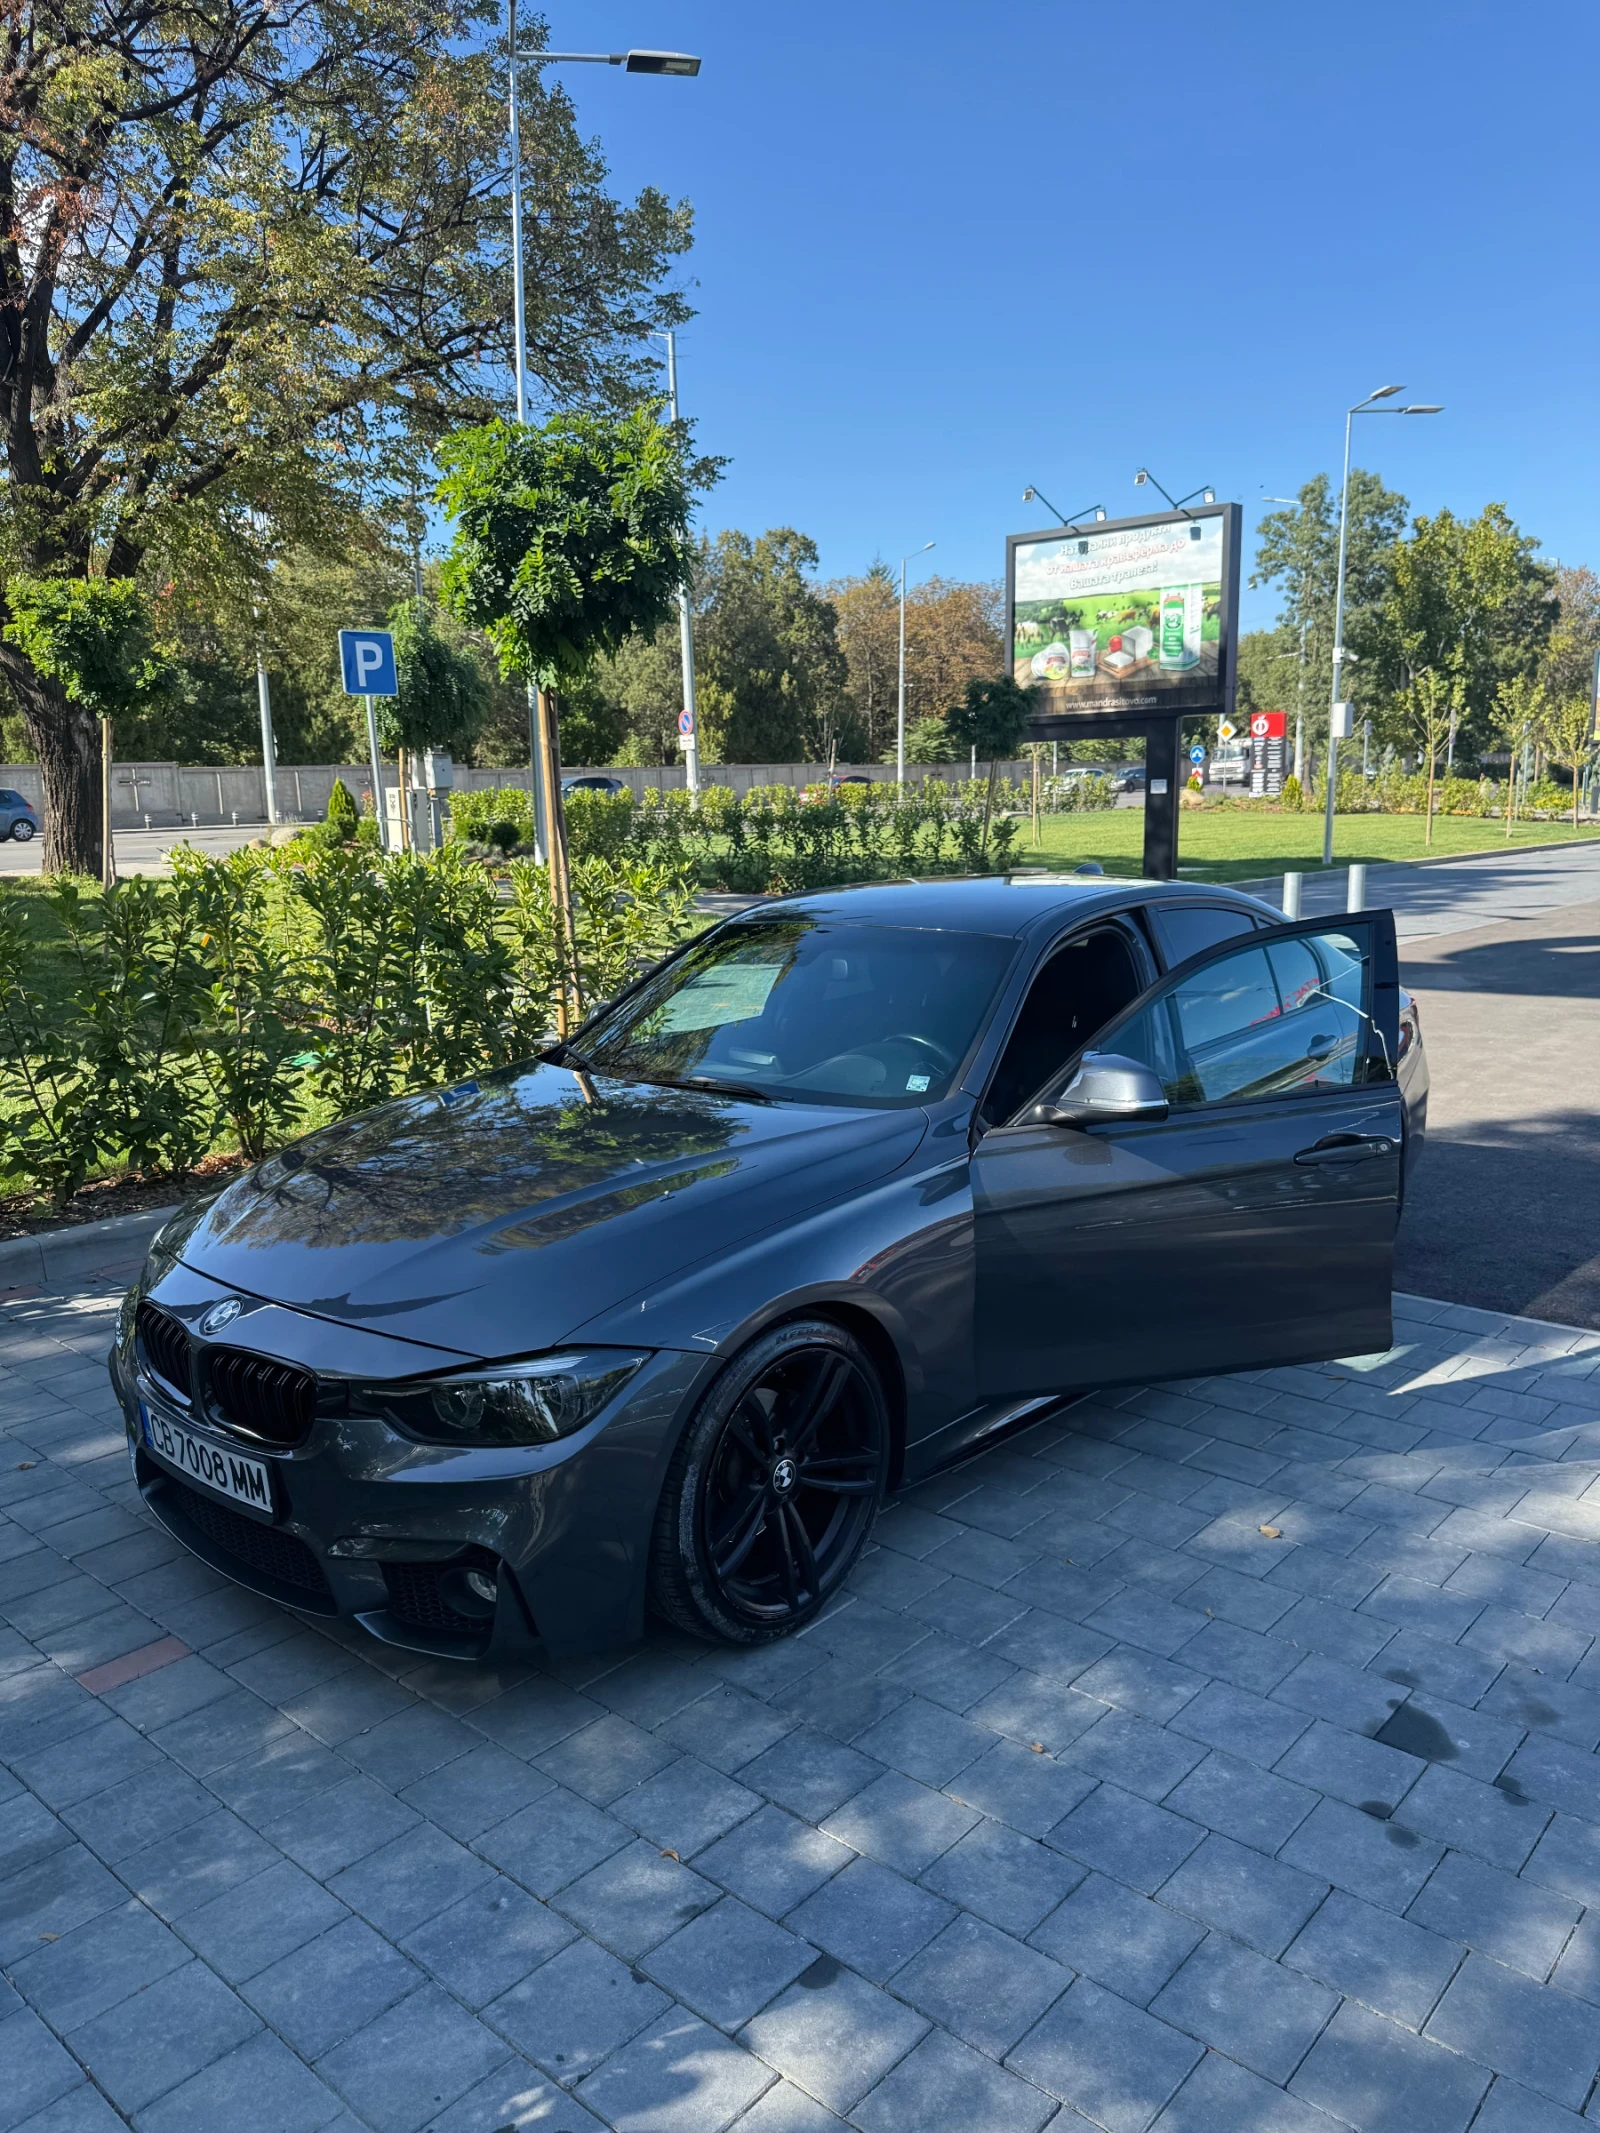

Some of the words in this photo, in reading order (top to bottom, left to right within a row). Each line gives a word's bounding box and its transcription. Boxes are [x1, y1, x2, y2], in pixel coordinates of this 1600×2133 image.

[1119, 525, 1171, 546] продукти
[1046, 566, 1059, 576] от
[1060, 560, 1099, 574] нашата
[1170, 540, 1186, 554] до
[1070, 573, 1110, 590] Вашата
[1112, 561, 1159, 584] трапеза!
[355, 641, 383, 687] P
[1065, 696, 1157, 710] www.mandrasitovo.com
